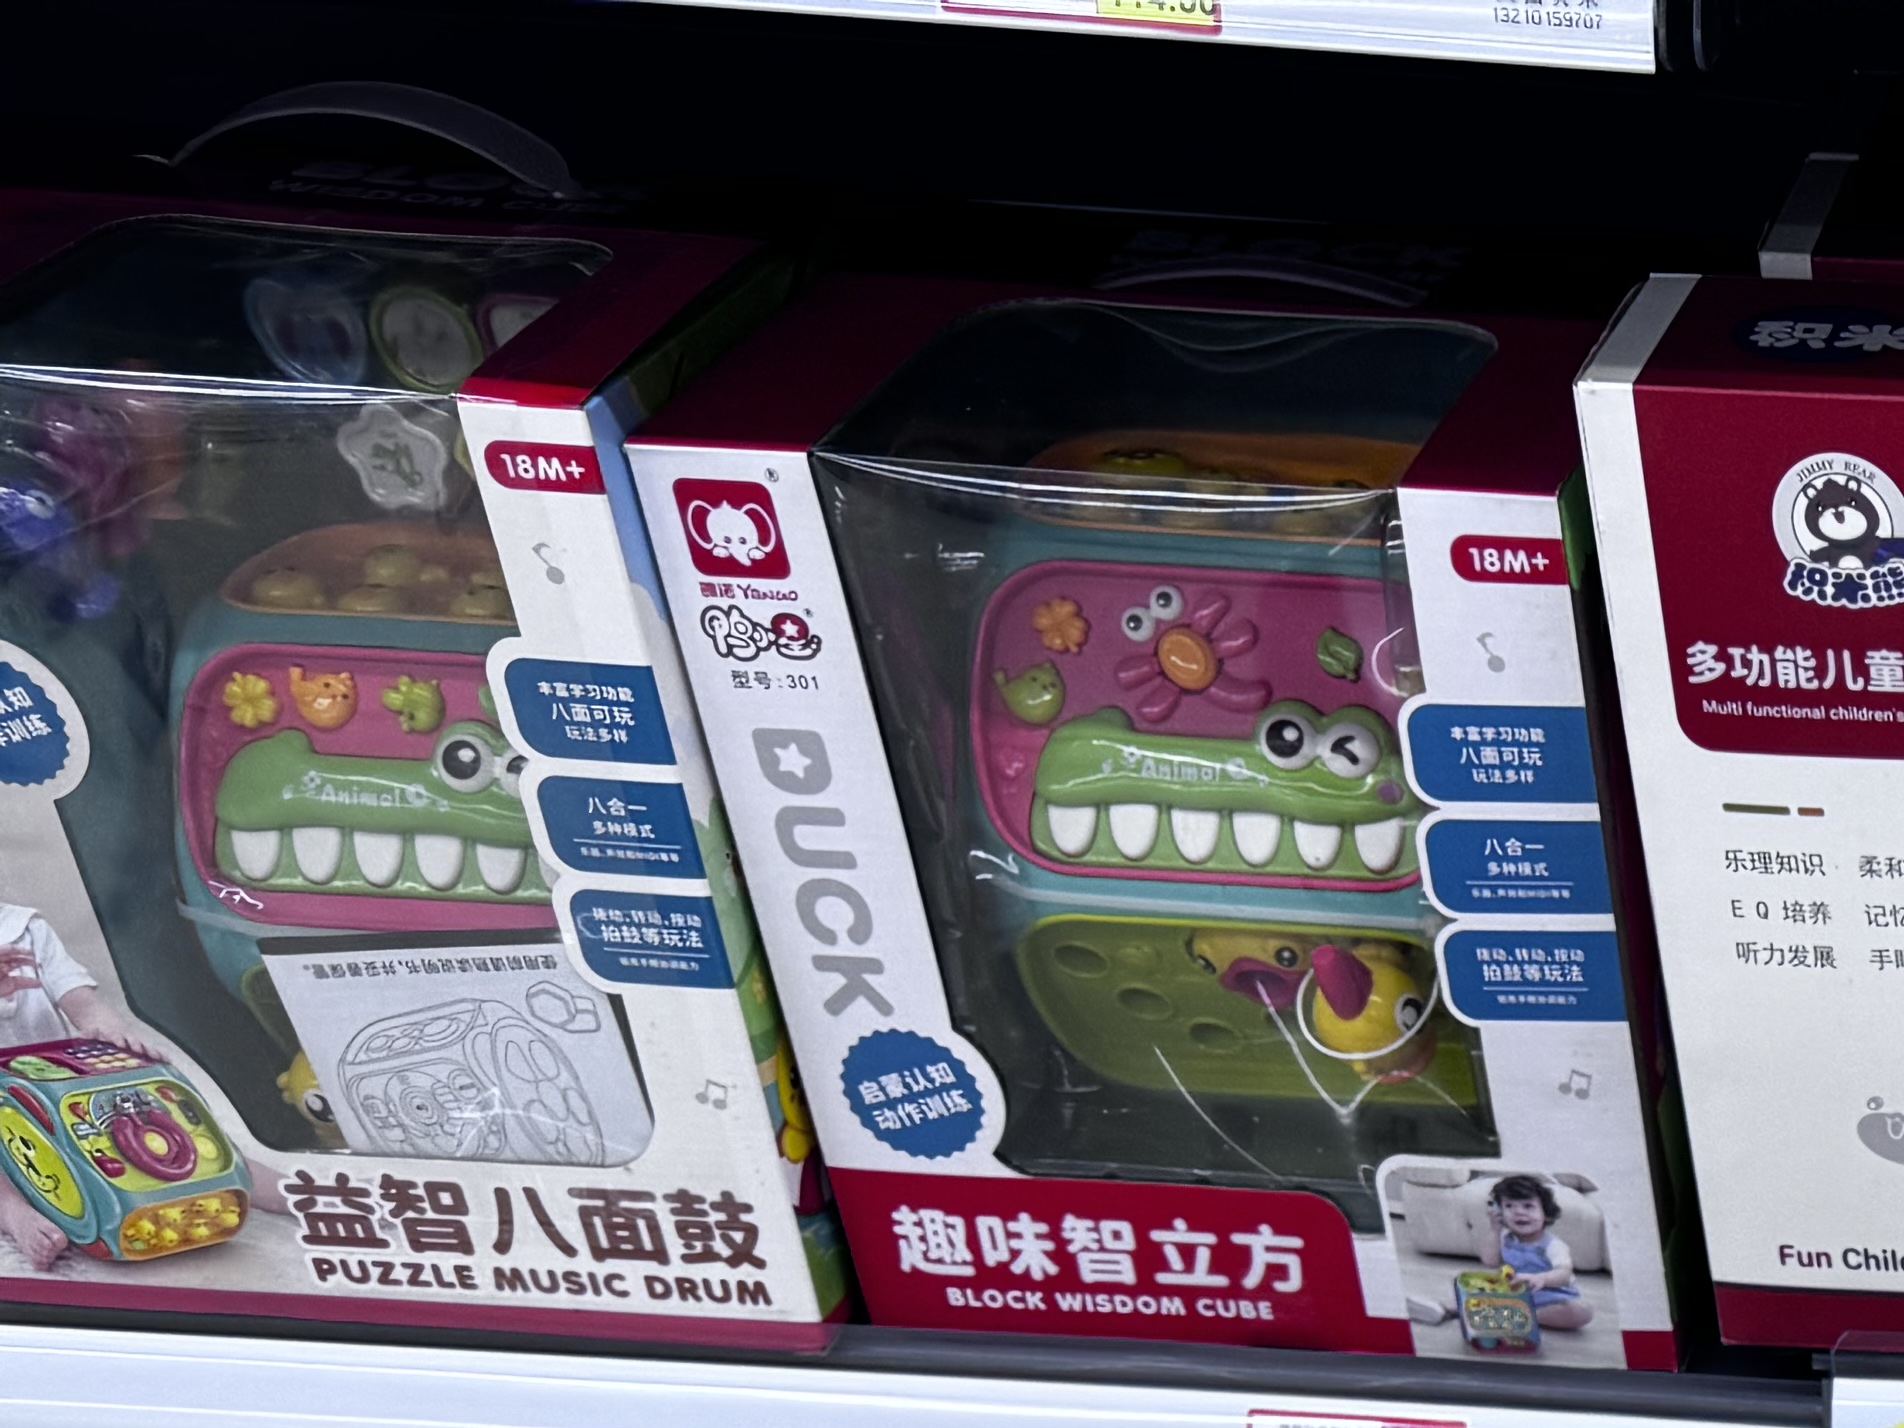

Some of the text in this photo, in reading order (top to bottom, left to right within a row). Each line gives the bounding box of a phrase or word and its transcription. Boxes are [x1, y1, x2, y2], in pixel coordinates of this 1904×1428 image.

[499, 452, 586, 482] 18M+
[1467, 545, 1549, 574] 18M+
[552, 702, 635, 725] 八面可玩
[1702, 699, 1742, 717] Multi
[1746, 700, 1825, 721] functional
[1829, 705, 1904, 724] children's
[1460, 746, 1543, 766] 八面可玩
[588, 797, 647, 817] 八合一
[1485, 838, 1545, 856] 八合一
[751, 727, 894, 1017] DUCK
[1724, 849, 1826, 878] 乐理知识
[1735, 941, 1838, 970] 听力发展
[857, 1062, 954, 1106] 启蒙认知
[872, 1091, 973, 1132] 动作训练
[284, 1171, 769, 1272] 益智八面鼓
[891, 1203, 1305, 1293] 趣味智立方
[1778, 1244, 1833, 1269] Fun
[314, 1257, 773, 1308] PUZZLE MUSIC DRUM
[946, 1287, 1274, 1321] BLOCK WISDOM CUBE
